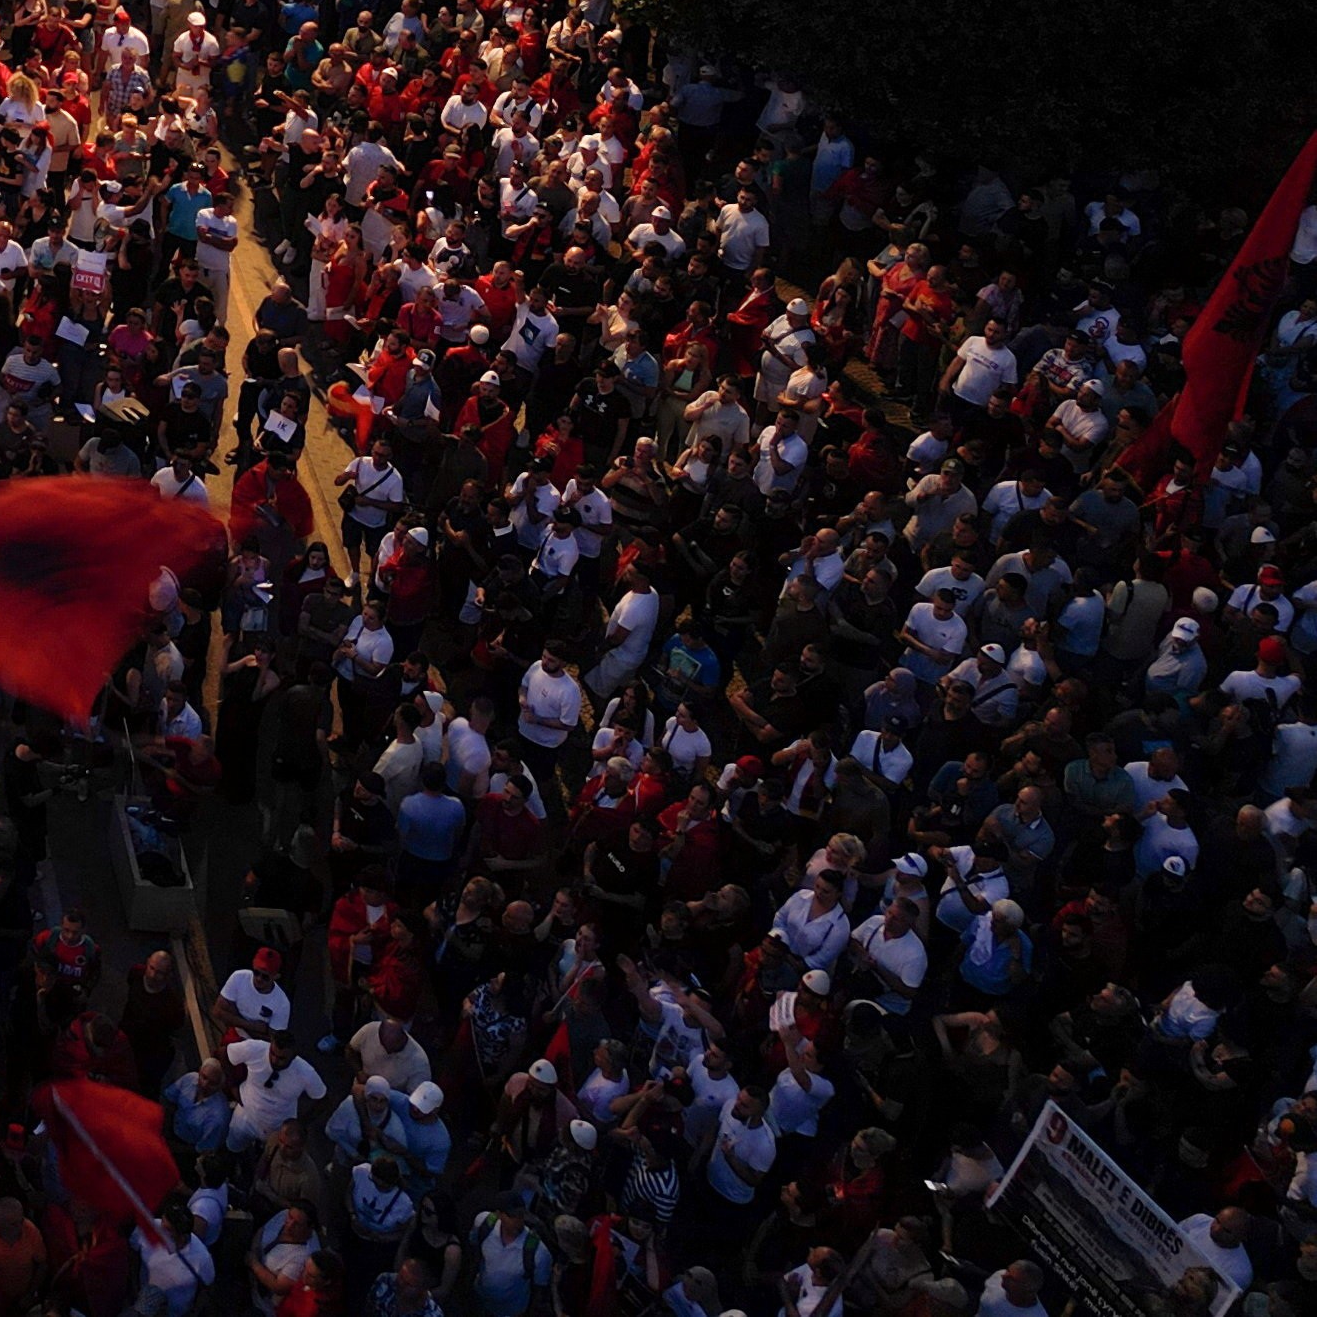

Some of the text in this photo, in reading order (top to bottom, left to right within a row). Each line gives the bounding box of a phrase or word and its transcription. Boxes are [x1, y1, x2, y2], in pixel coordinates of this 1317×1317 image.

[1066, 1137, 1118, 1197] MALET
[1116, 1187, 1131, 1205] E
[1130, 1197, 1184, 1256] DIBRËS
